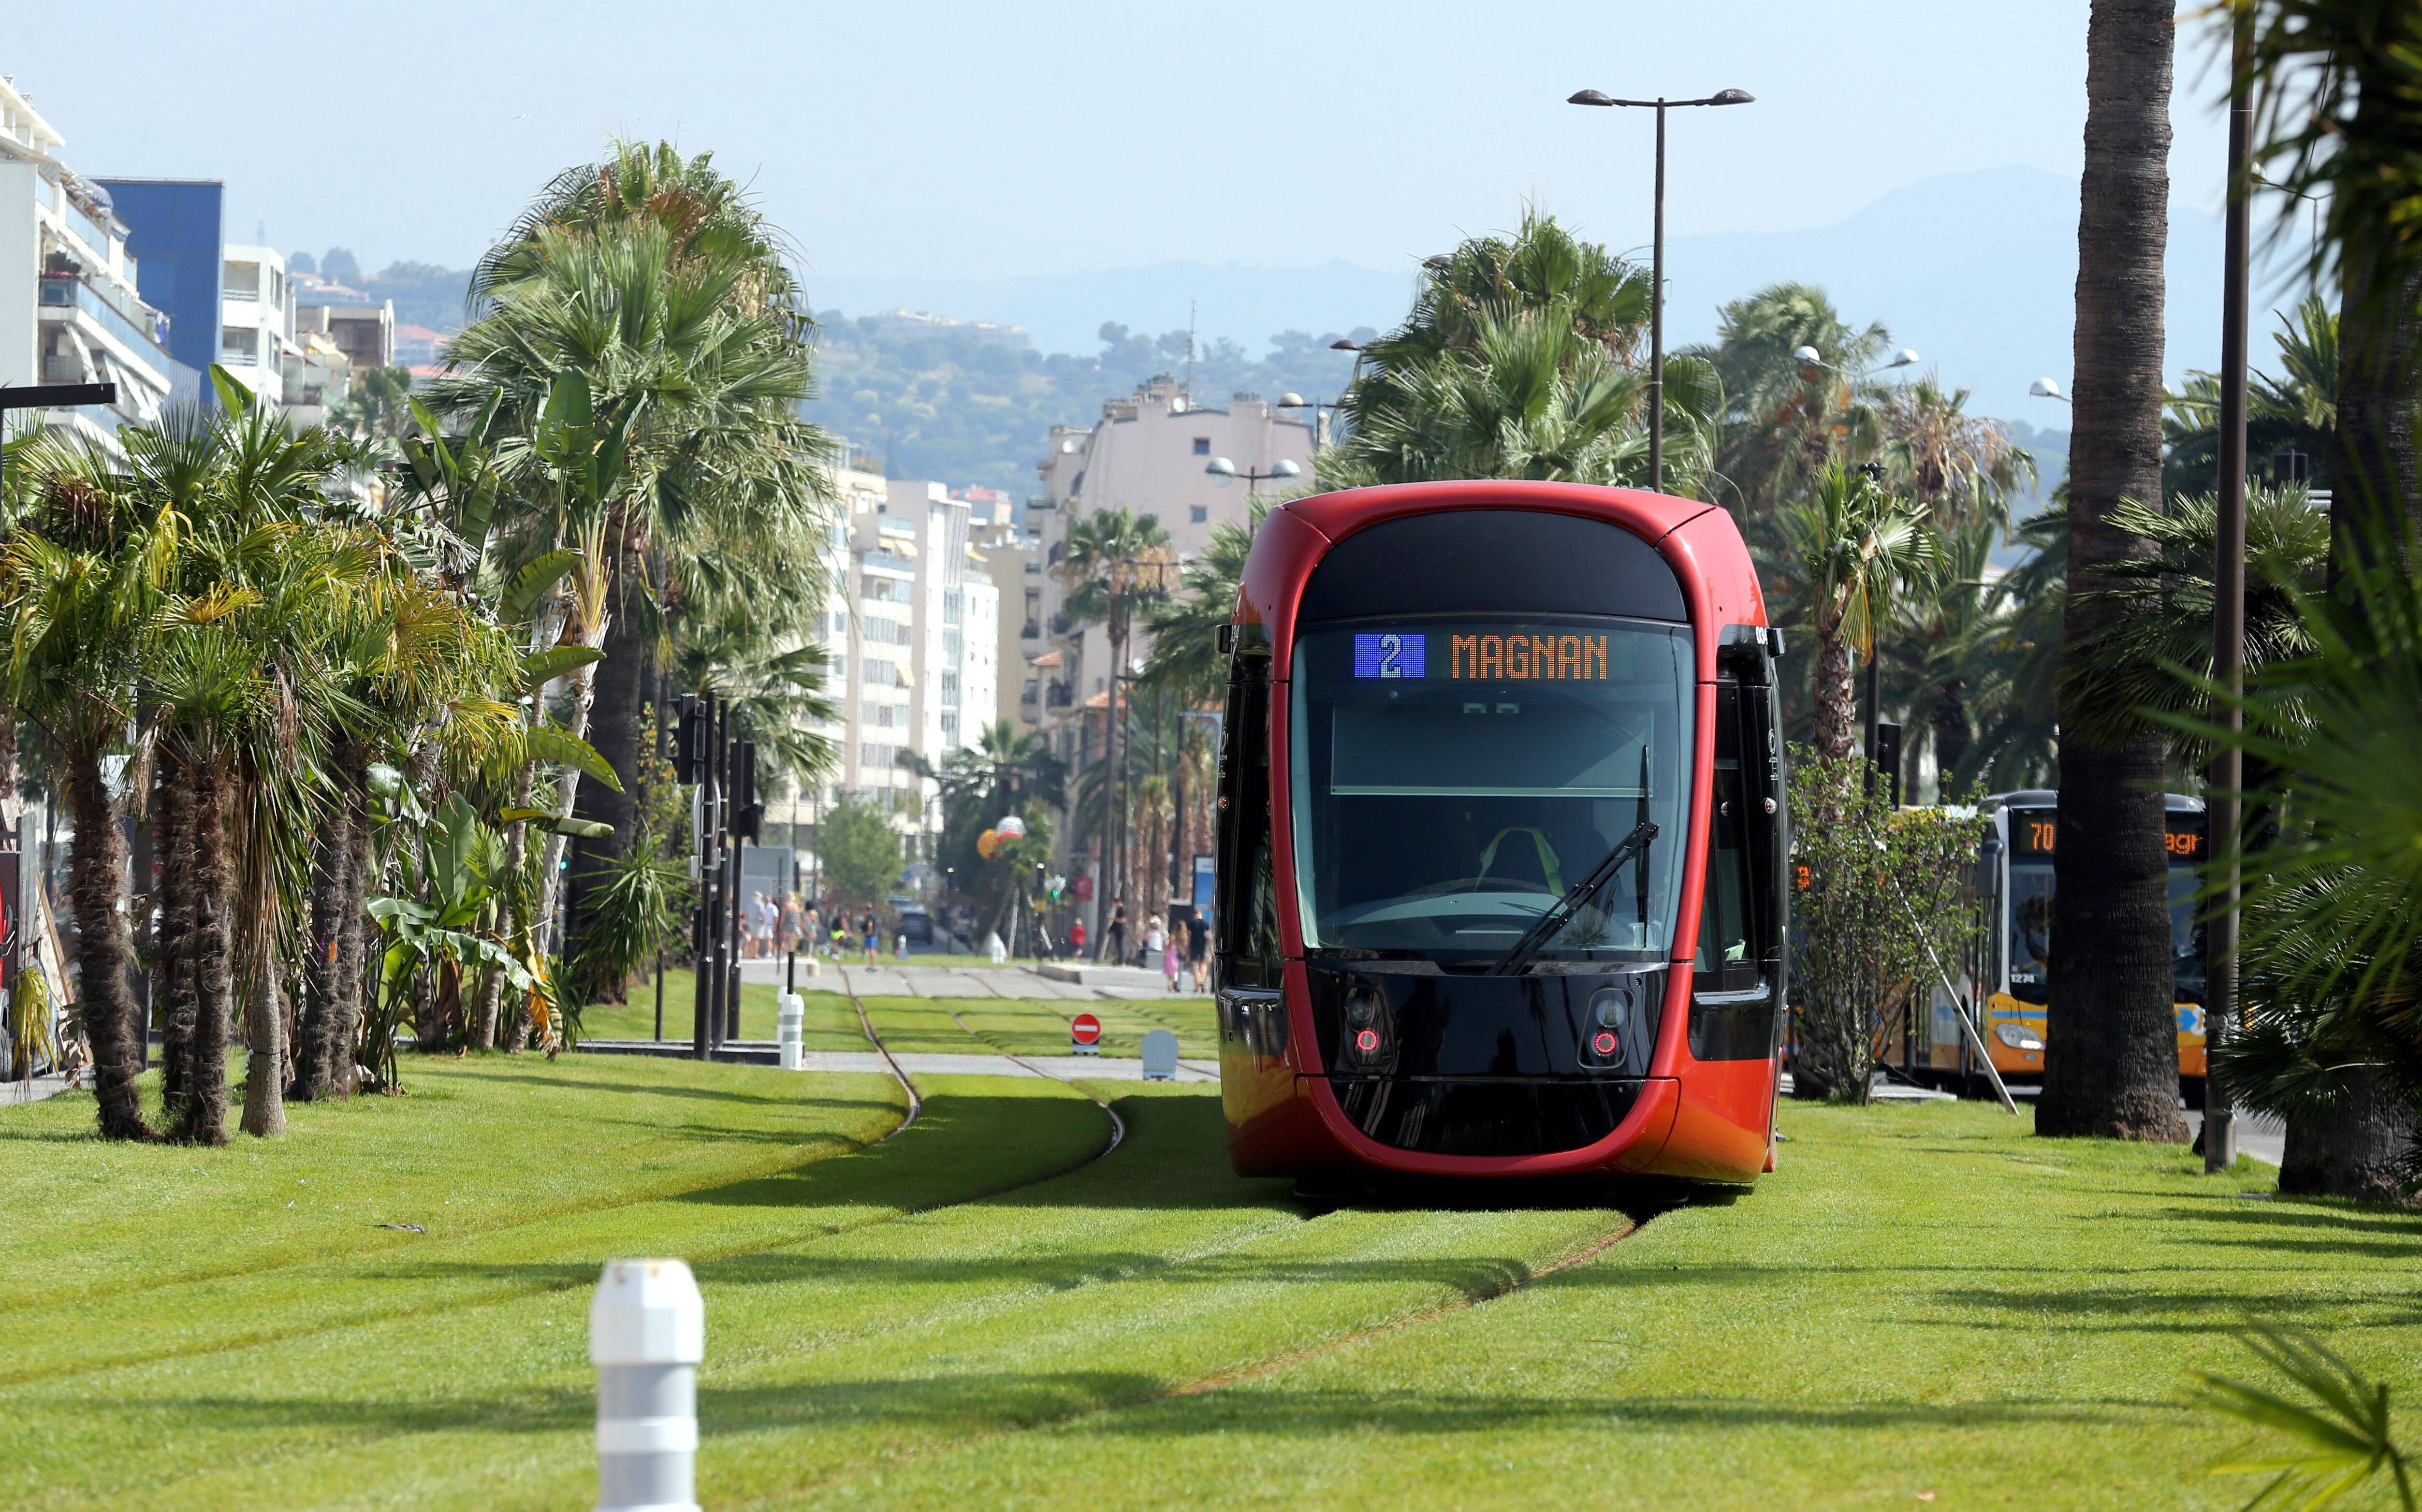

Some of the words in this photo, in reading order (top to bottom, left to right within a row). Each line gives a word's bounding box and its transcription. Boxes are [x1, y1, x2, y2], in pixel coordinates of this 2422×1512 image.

[1381, 634, 1401, 678] 2
[1452, 635, 1607, 679] MAGNAN
[2030, 823, 2054, 850] 70
[2011, 974, 2034, 983] 1274
